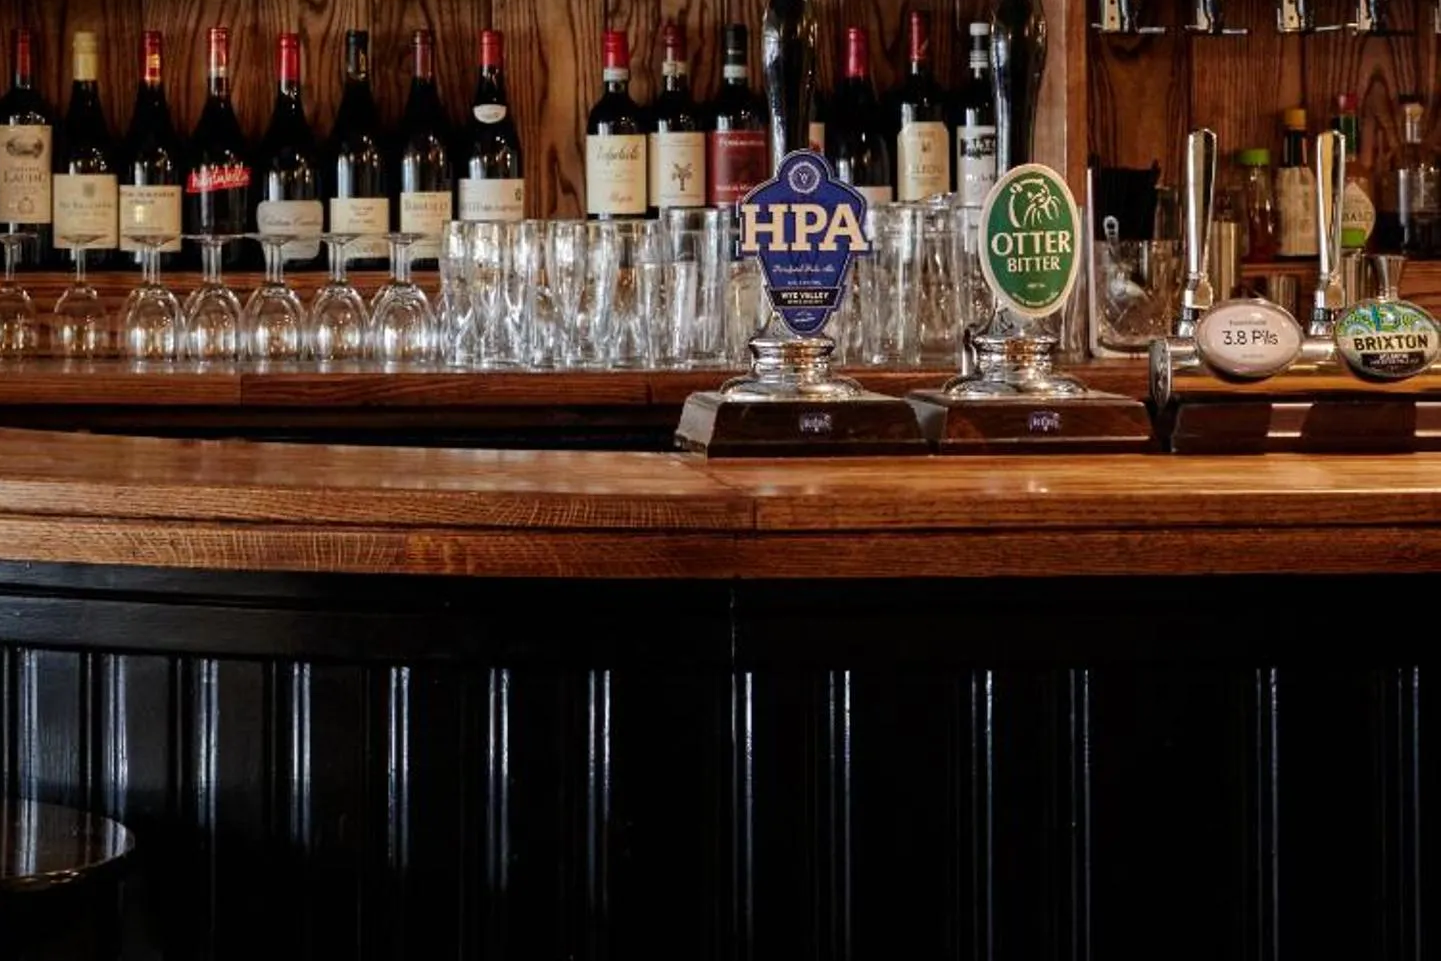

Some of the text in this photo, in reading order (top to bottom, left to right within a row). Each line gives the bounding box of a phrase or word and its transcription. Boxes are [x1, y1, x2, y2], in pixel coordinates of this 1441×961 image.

[740, 203, 871, 252] HPA
[991, 230, 1072, 257] OTTER
[1007, 256, 1061, 273] BITTER
[1222, 328, 1279, 346] 3.8 Pils
[1353, 334, 1429, 352] BRIXTON
